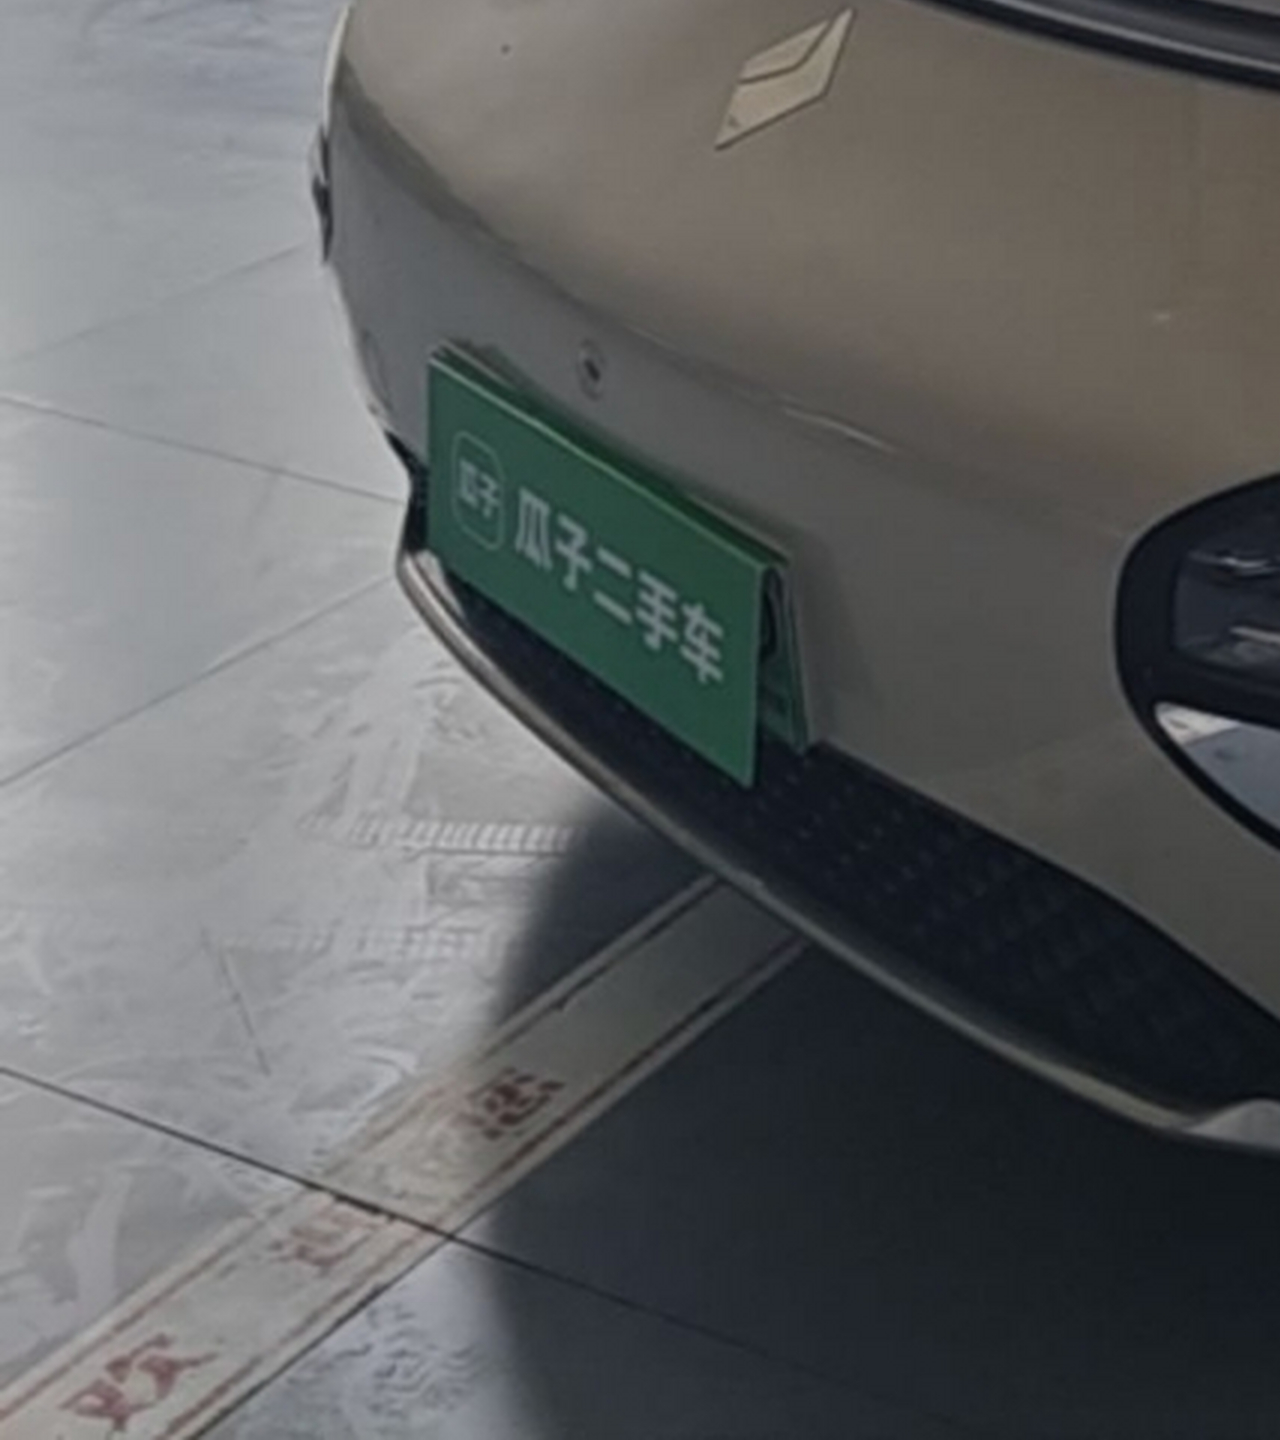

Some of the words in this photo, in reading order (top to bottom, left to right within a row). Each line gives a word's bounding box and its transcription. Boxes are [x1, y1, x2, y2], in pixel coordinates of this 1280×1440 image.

[515, 488, 723, 685] 瓜子二手车
